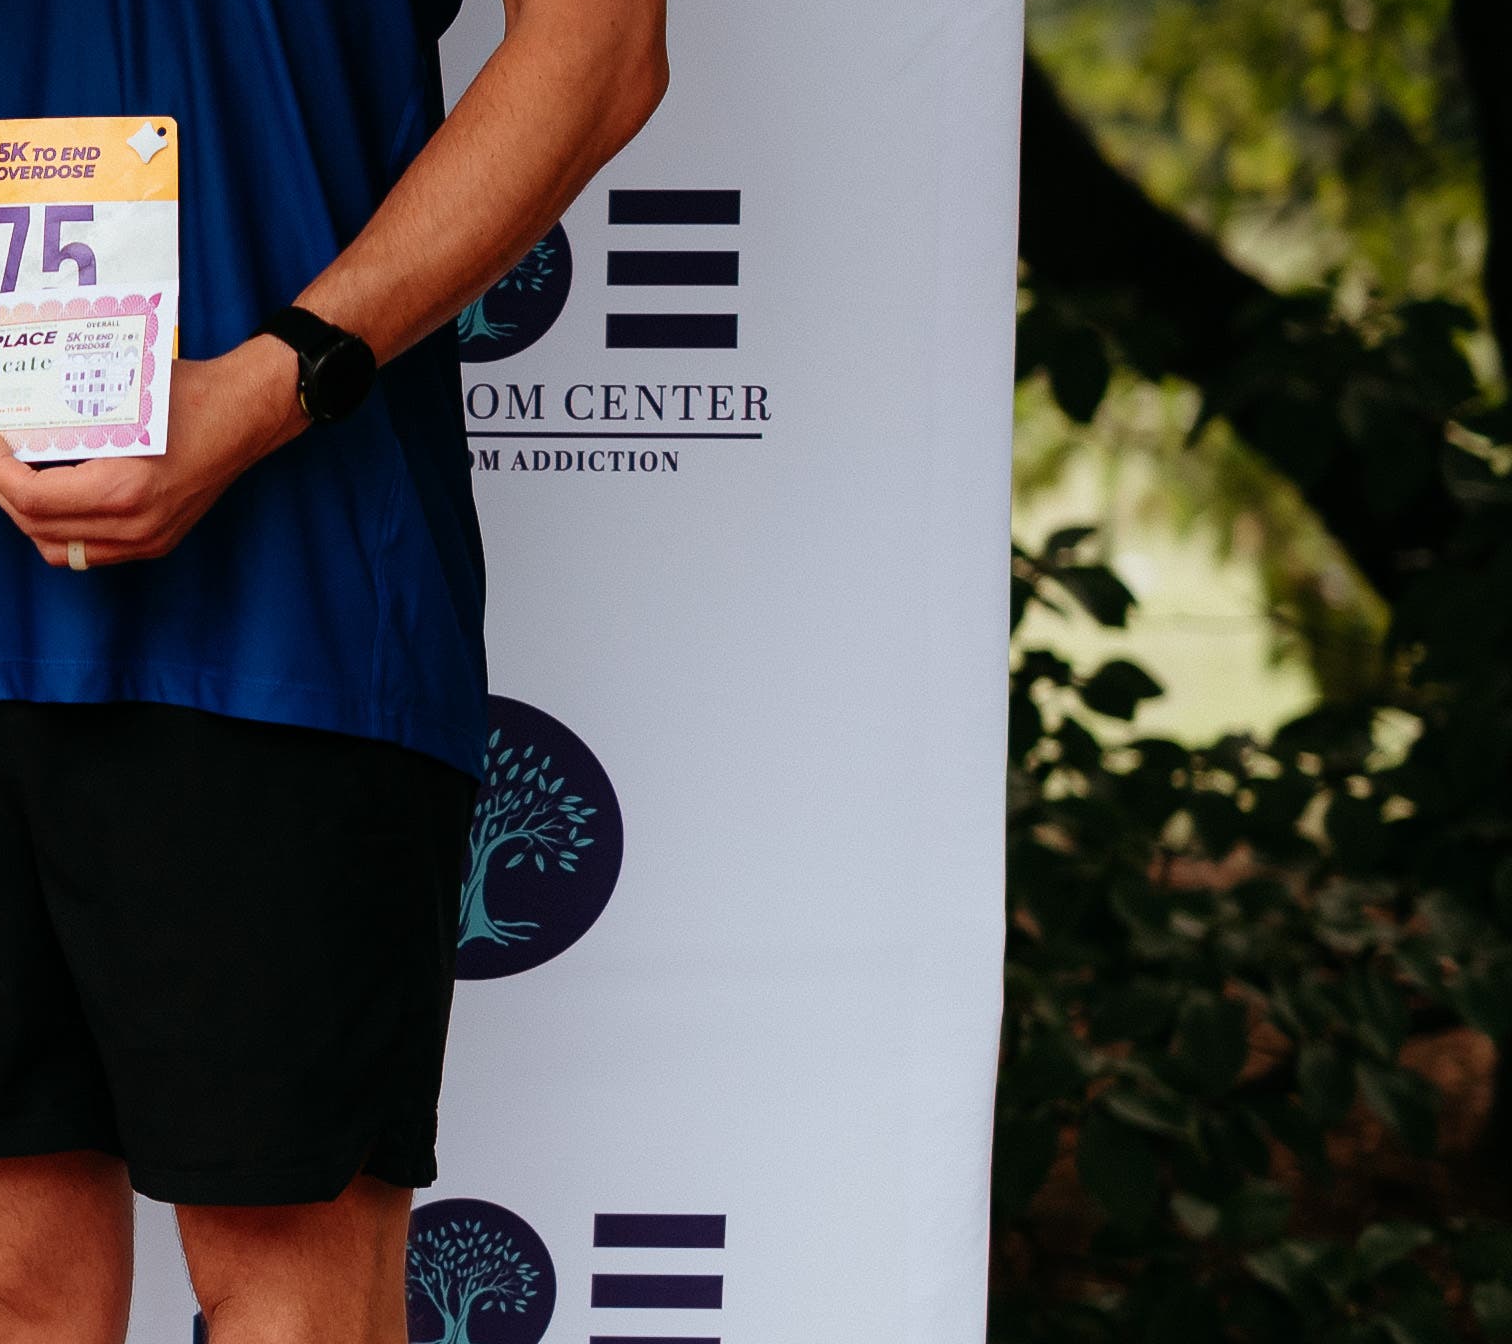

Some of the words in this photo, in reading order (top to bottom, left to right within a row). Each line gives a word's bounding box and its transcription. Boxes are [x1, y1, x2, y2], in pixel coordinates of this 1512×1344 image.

[32, 147, 57, 161] TO
[60, 146, 101, 161] END
[563, 383, 773, 422] CENTER
[509, 449, 680, 473] ADDICTION
